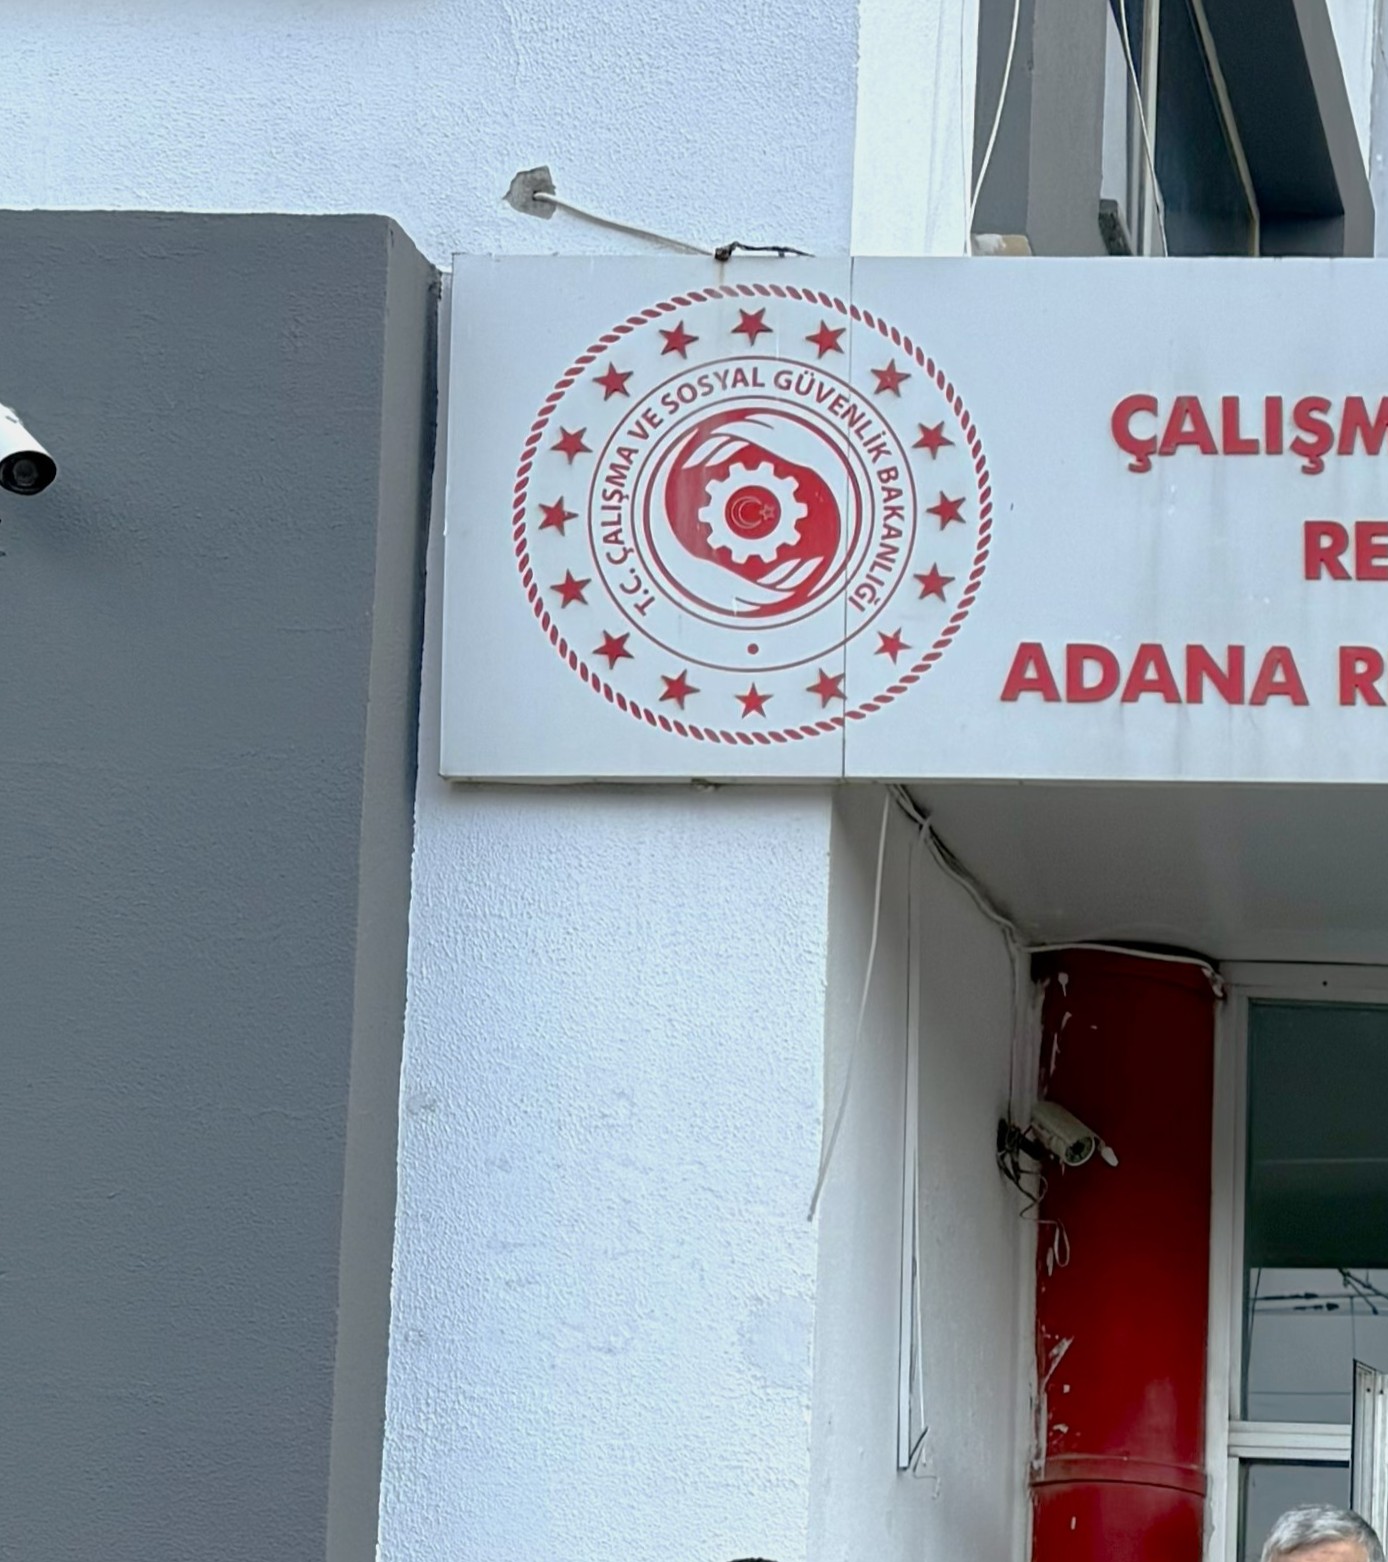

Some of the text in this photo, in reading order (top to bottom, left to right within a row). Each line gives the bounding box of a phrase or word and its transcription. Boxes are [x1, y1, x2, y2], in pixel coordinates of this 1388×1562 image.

[601, 367, 906, 617] T.C. ÇALIŞMA VE SOSYAL GÜVENLİK BAKANLIĞI
[1000, 642, 1309, 707] ADANA
